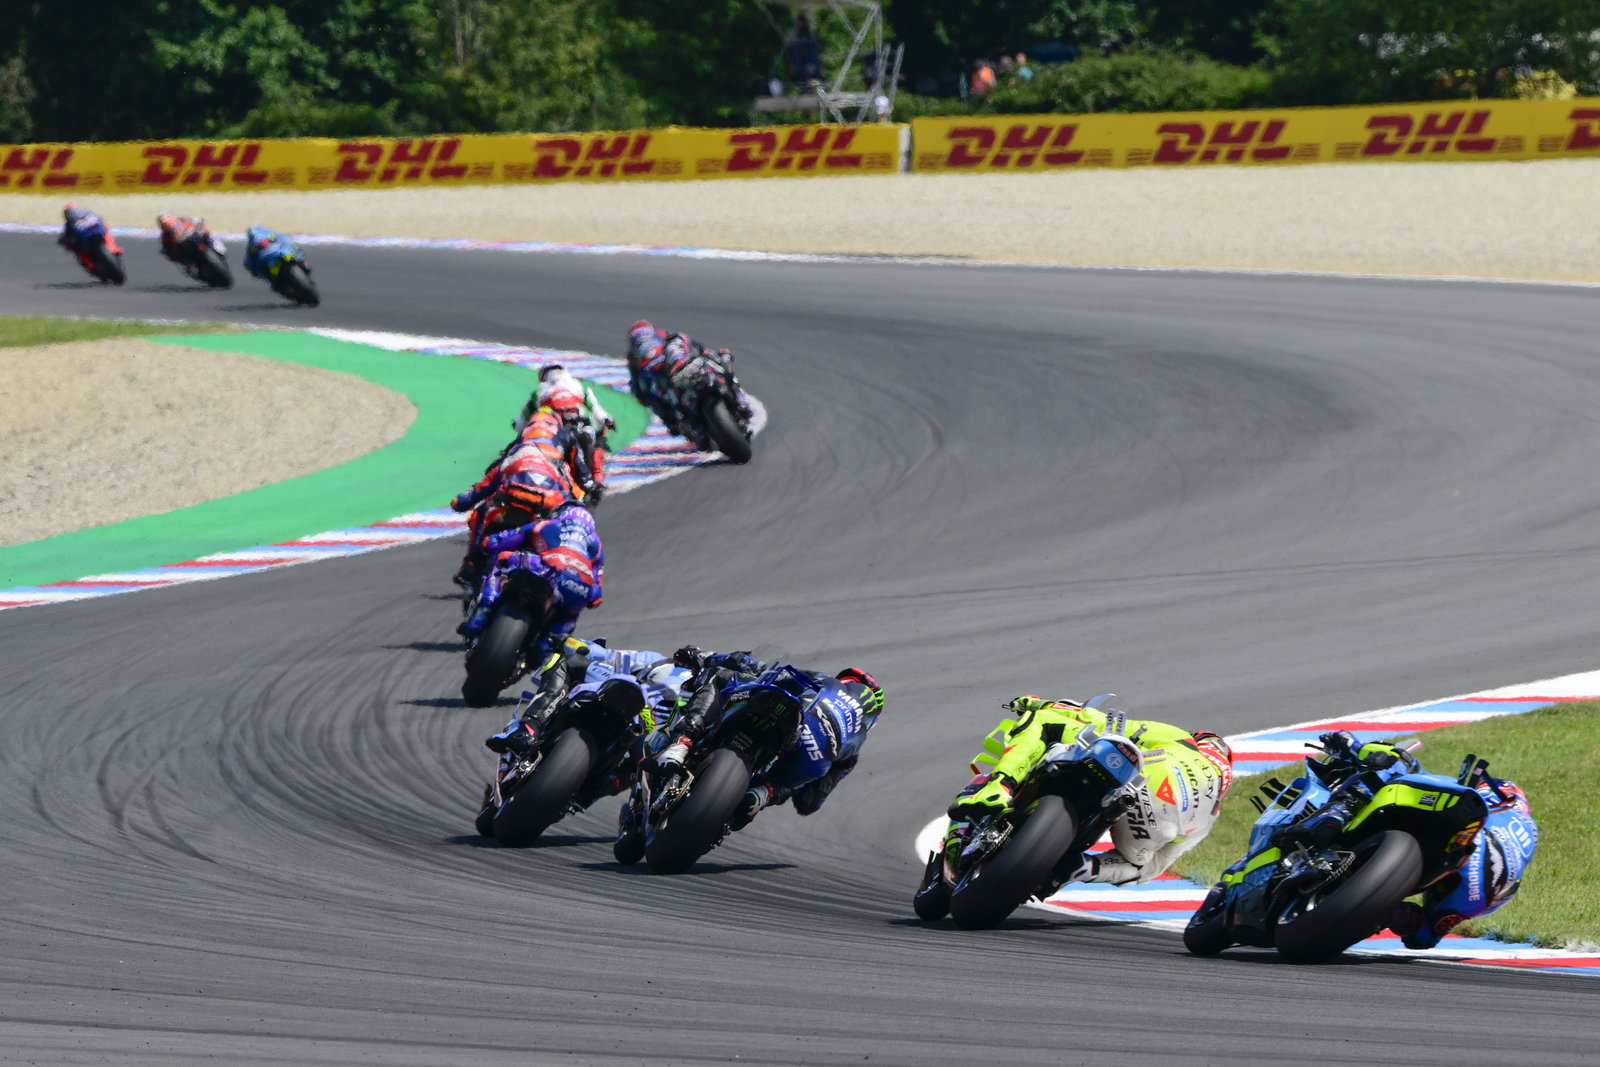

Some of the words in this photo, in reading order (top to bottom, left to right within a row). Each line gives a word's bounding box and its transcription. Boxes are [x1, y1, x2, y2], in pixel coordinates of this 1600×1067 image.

[725, 128, 863, 172] DHL
[947, 125, 1083, 167] DHL
[1154, 120, 1290, 163] DHL
[1363, 111, 1495, 156] DHL
[0, 147, 80, 188] HL
[140, 143, 269, 185] DHL
[334, 138, 469, 183] DHL
[530, 134, 656, 178] DHL
[833, 698, 853, 733] prima
[837, 690, 864, 734] YAMAHA
[1179, 760, 1200, 809] DUCATI
